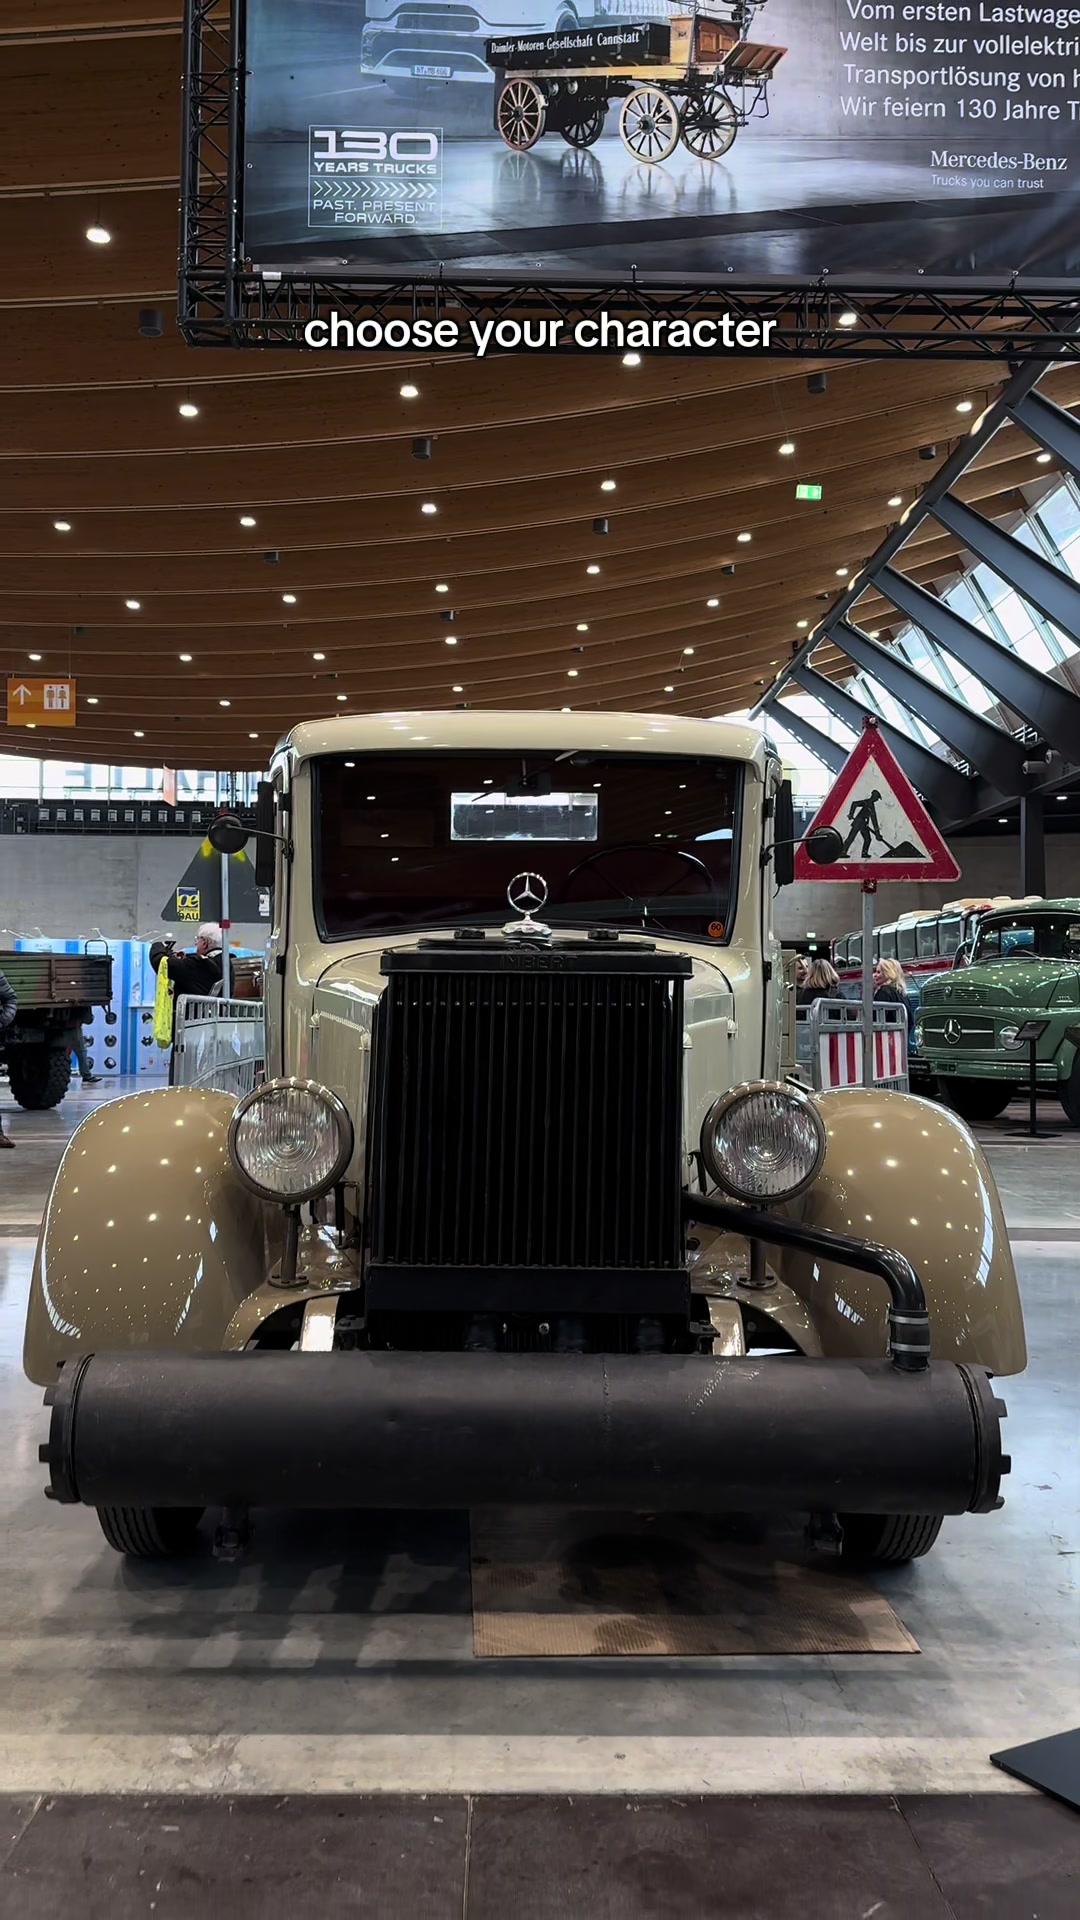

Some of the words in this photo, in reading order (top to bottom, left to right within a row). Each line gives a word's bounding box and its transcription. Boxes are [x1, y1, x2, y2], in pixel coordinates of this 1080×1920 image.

[846, 0, 895, 20] Vom
[902, 3, 971, 22] ersten
[979, 2, 1080, 29] Lastwage
[490, 33, 593, 54] Daimler-Motoren-Gesellschaft
[597, 31, 640, 47] Cannstatt
[839, 31, 888, 52] Welt
[896, 32, 927, 53] bis
[933, 38, 967, 54] zur
[974, 35, 1080, 56] vollelektri
[843, 64, 1021, 92] Transportlösung
[1027, 72, 1065, 88] von
[840, 96, 877, 116] Wir
[884, 97, 946, 118] feiern
[957, 98, 997, 119] 130
[1003, 99, 1060, 121] Jahre
[314, 130, 438, 161] 130
[314, 162, 369, 173] YEARS
[372, 163, 437, 175] TRUCKS
[930, 150, 1068, 171] Mercedes-Benz
[931, 174, 967, 187] Trucks
[970, 177, 990, 190] you
[994, 179, 1014, 189] can
[1018, 178, 1044, 189] trust
[313, 200, 357, 211] PAST.
[334, 213, 419, 224] FORWARD.
[711, 923, 722, 931] 60
